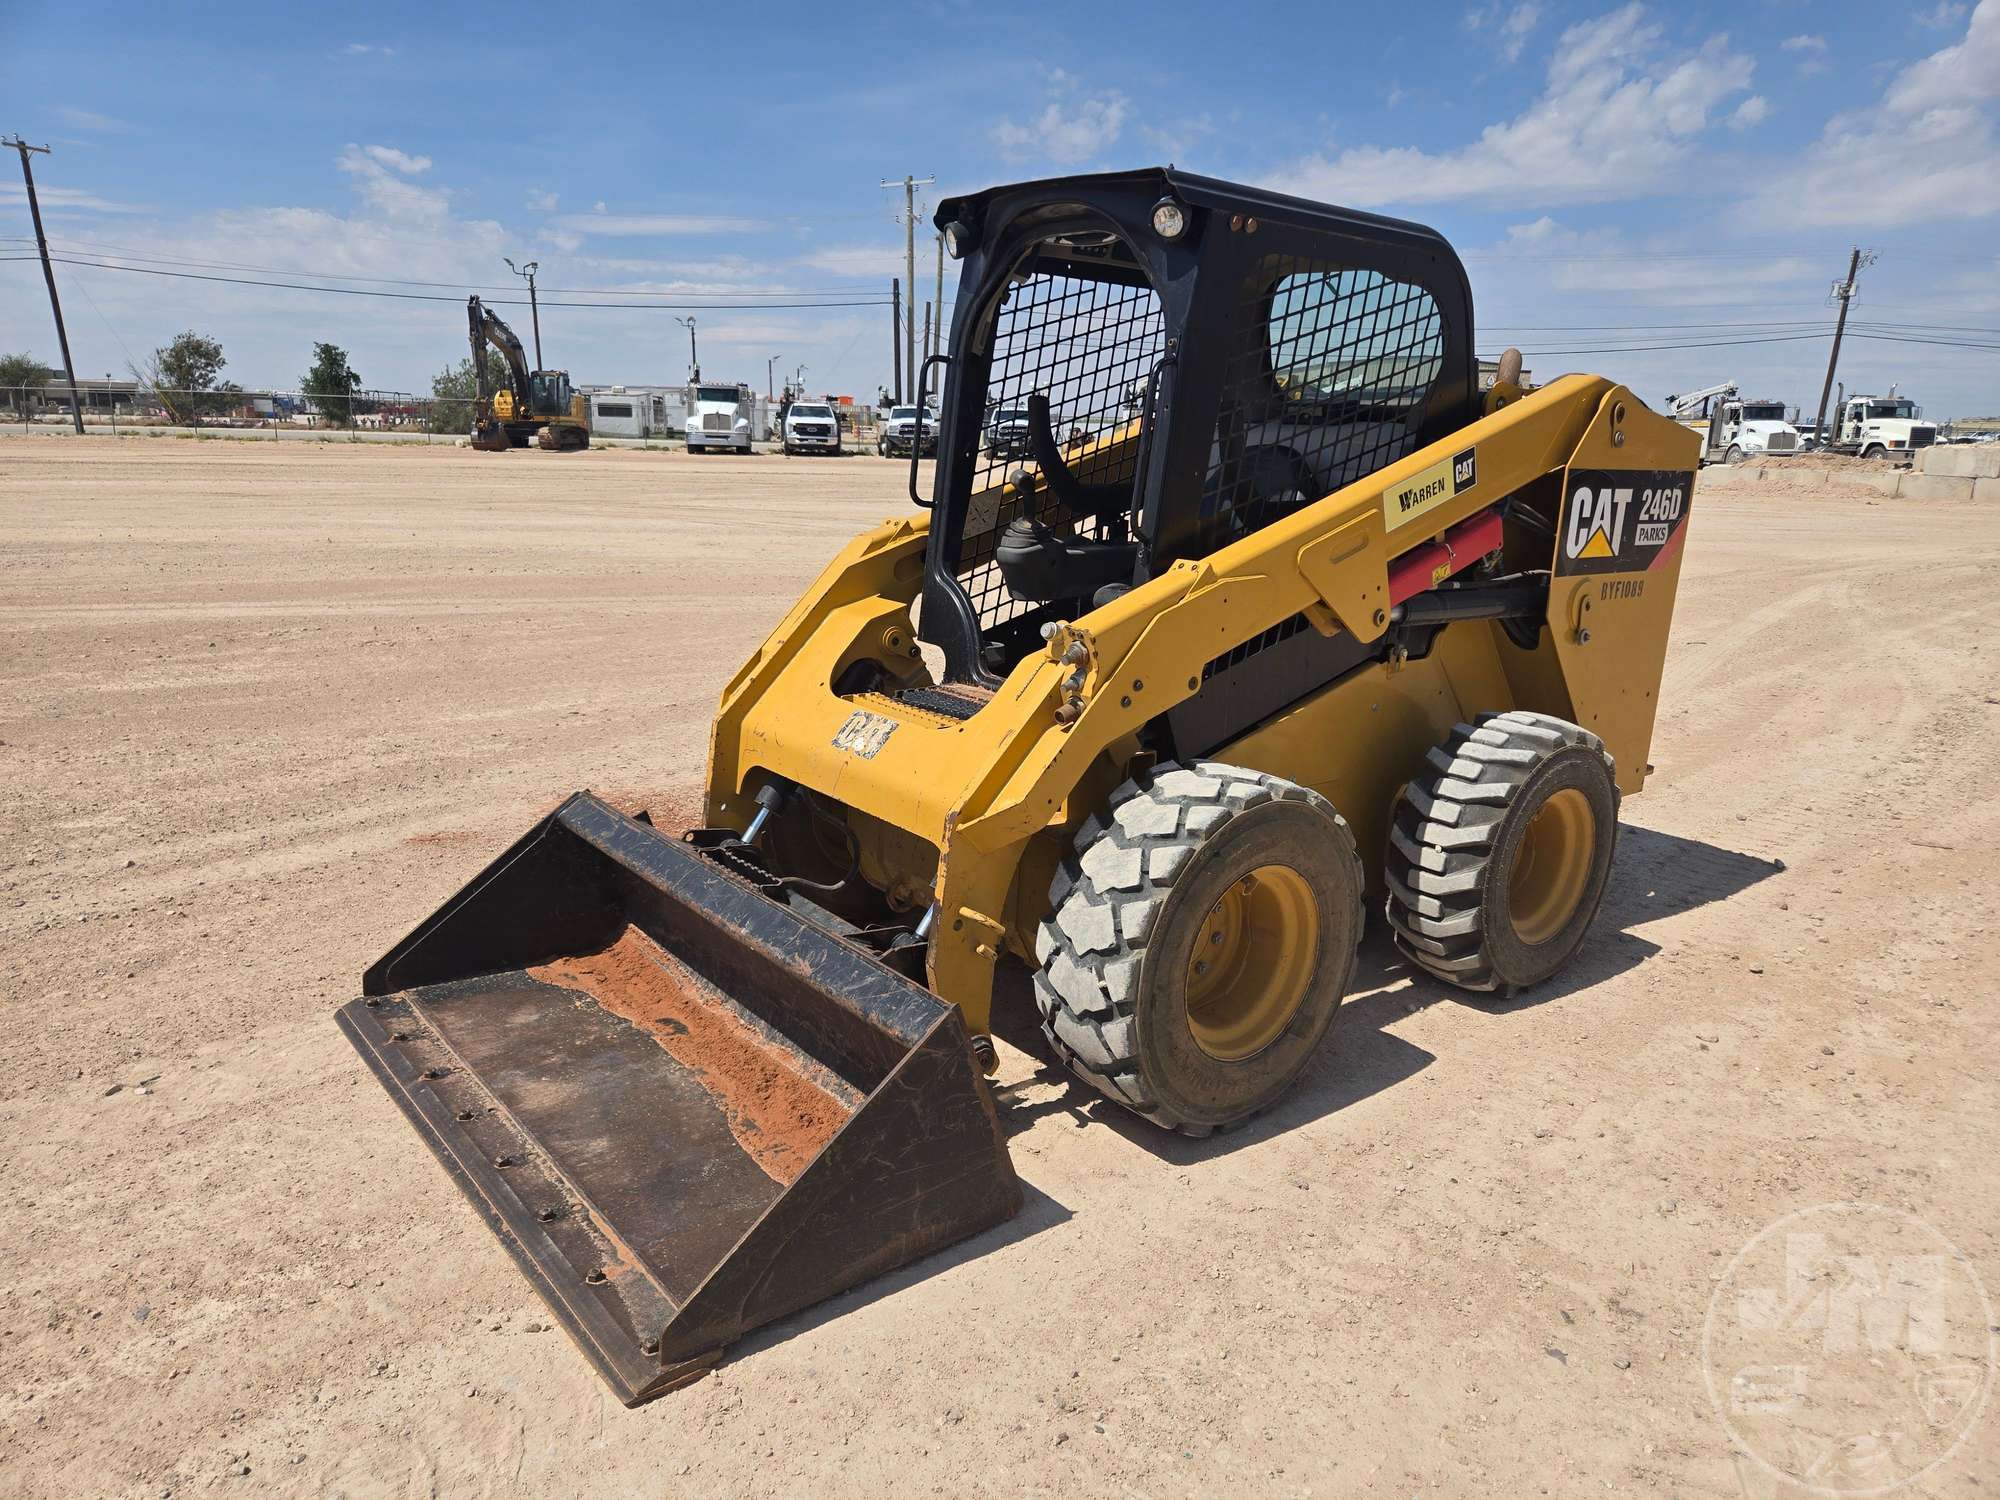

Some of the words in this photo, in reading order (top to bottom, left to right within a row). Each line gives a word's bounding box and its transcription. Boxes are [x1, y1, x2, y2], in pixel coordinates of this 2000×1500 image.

[1455, 458, 1474, 484] CAT
[1398, 477, 1446, 512] WARREN
[1639, 488, 1682, 520] 246D
[1566, 486, 1633, 559] CAT
[1638, 526, 1667, 543] PARKS
